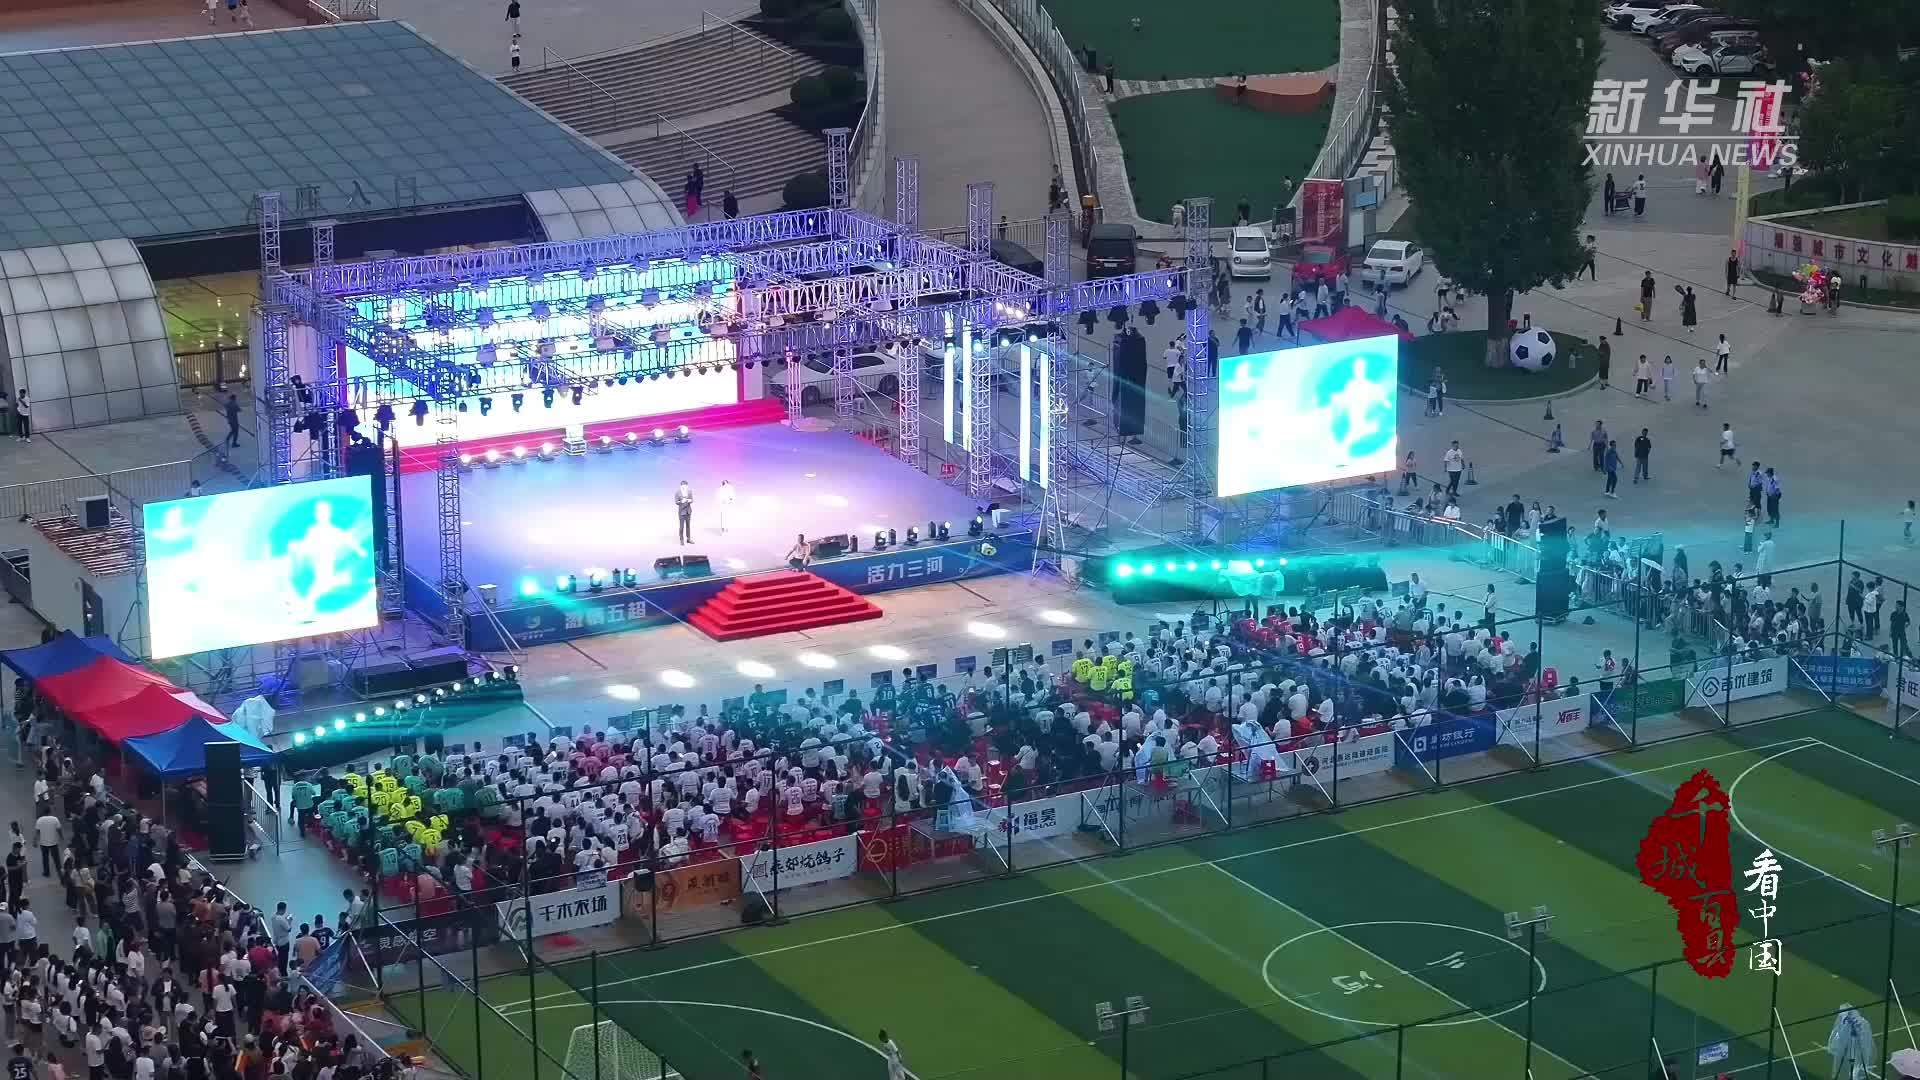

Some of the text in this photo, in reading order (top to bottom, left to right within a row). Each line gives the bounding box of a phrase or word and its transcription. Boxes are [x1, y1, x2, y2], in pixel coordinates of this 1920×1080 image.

[867, 555, 944, 584] 活力三河
[1023, 807, 1056, 826] 福昊
[13, 1067, 28, 1079] 25
